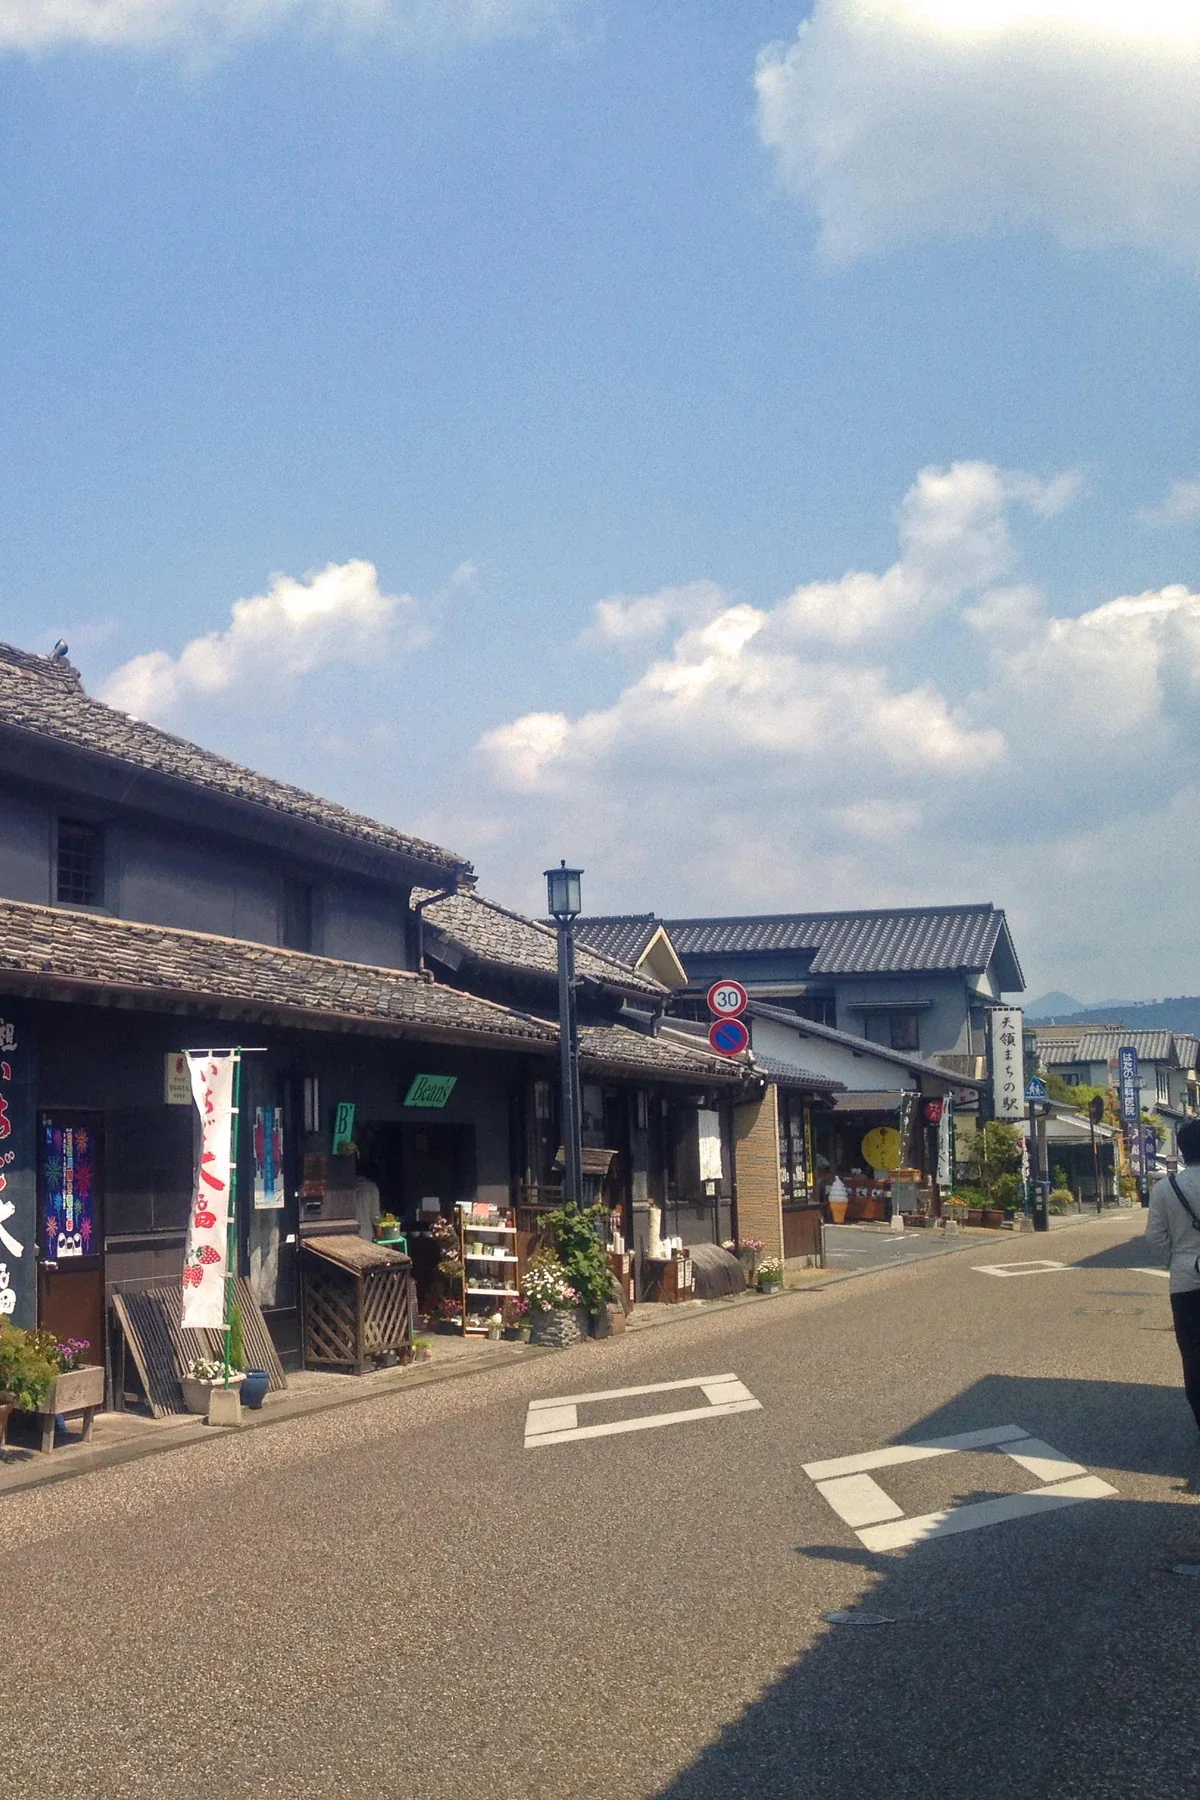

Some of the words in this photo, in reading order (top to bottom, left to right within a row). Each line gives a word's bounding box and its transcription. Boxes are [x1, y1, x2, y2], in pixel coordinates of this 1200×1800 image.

[717, 991, 738, 1007] 30
[999, 1016, 1020, 1112] 天領まちの駅
